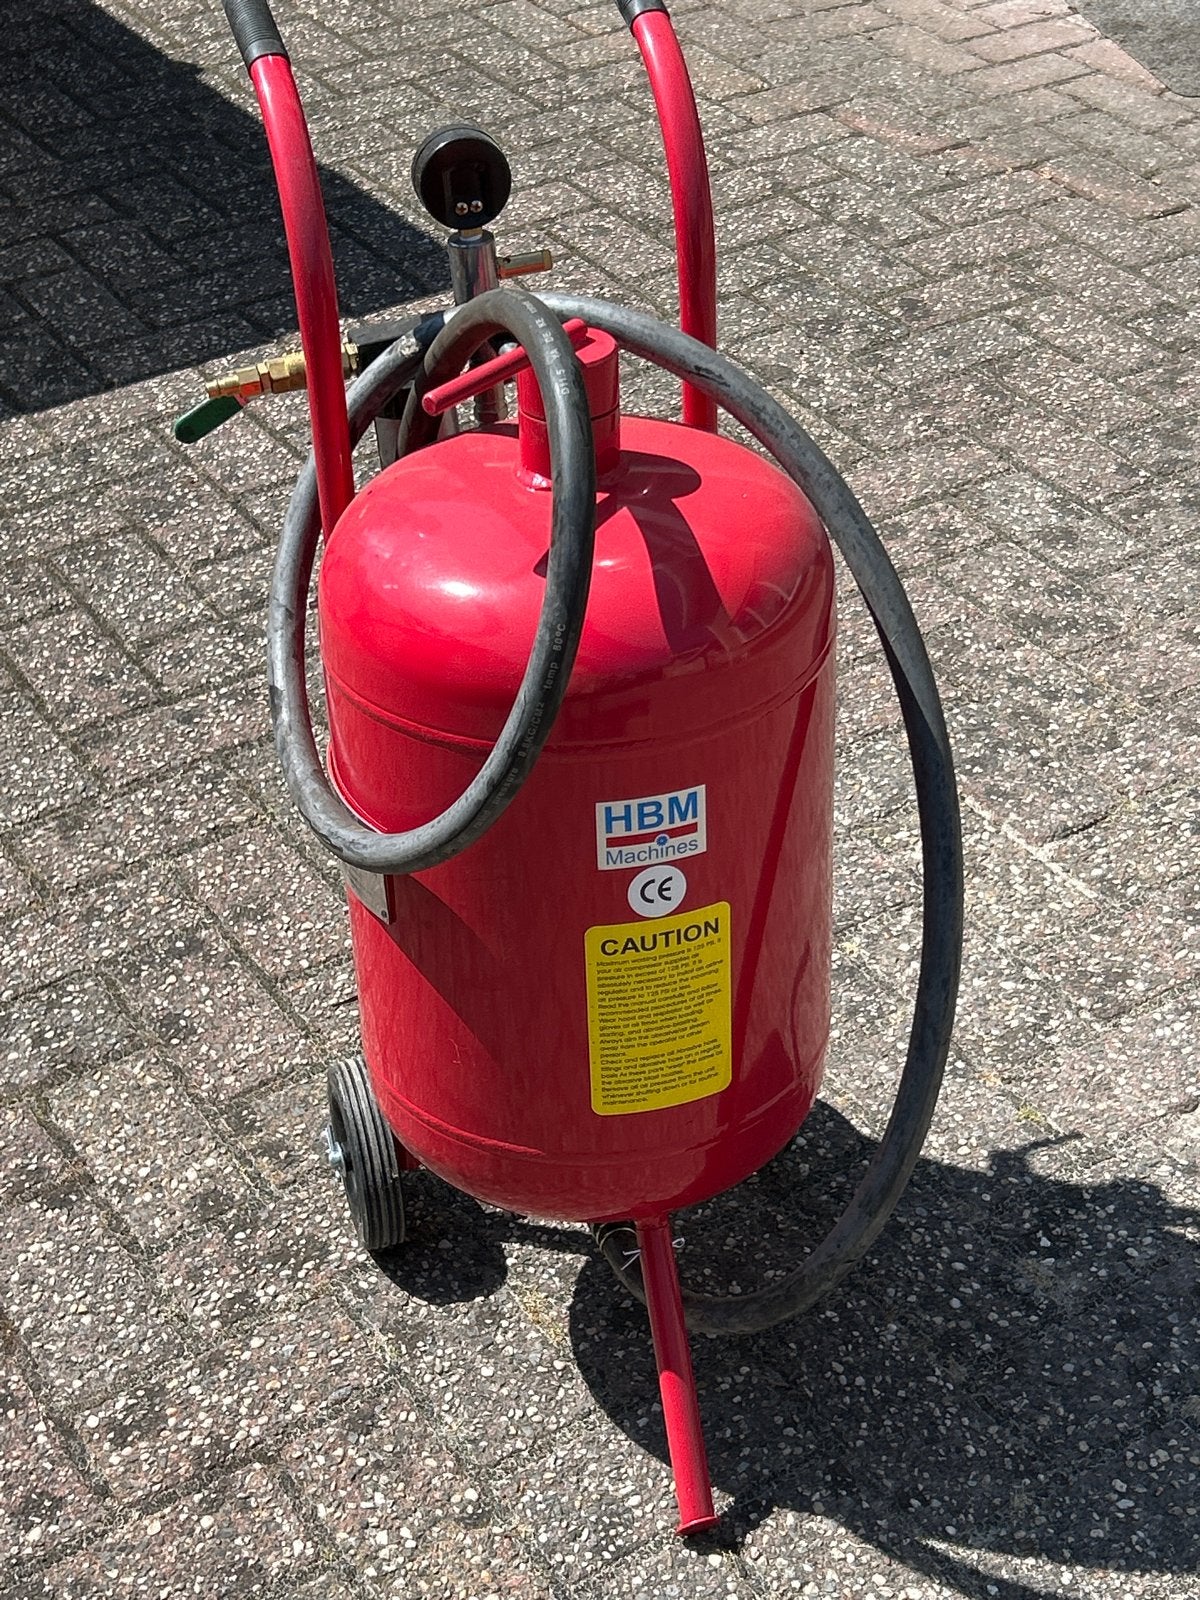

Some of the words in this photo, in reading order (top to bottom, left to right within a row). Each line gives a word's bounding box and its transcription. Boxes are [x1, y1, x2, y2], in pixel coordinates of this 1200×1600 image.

[604, 791, 698, 834] HBM
[606, 839, 698, 866] Machines
[640, 876, 673, 904] CE
[600, 917, 720, 956] CAUTION
[608, 995, 637, 1003] pressure
[631, 998, 656, 1007] manual
